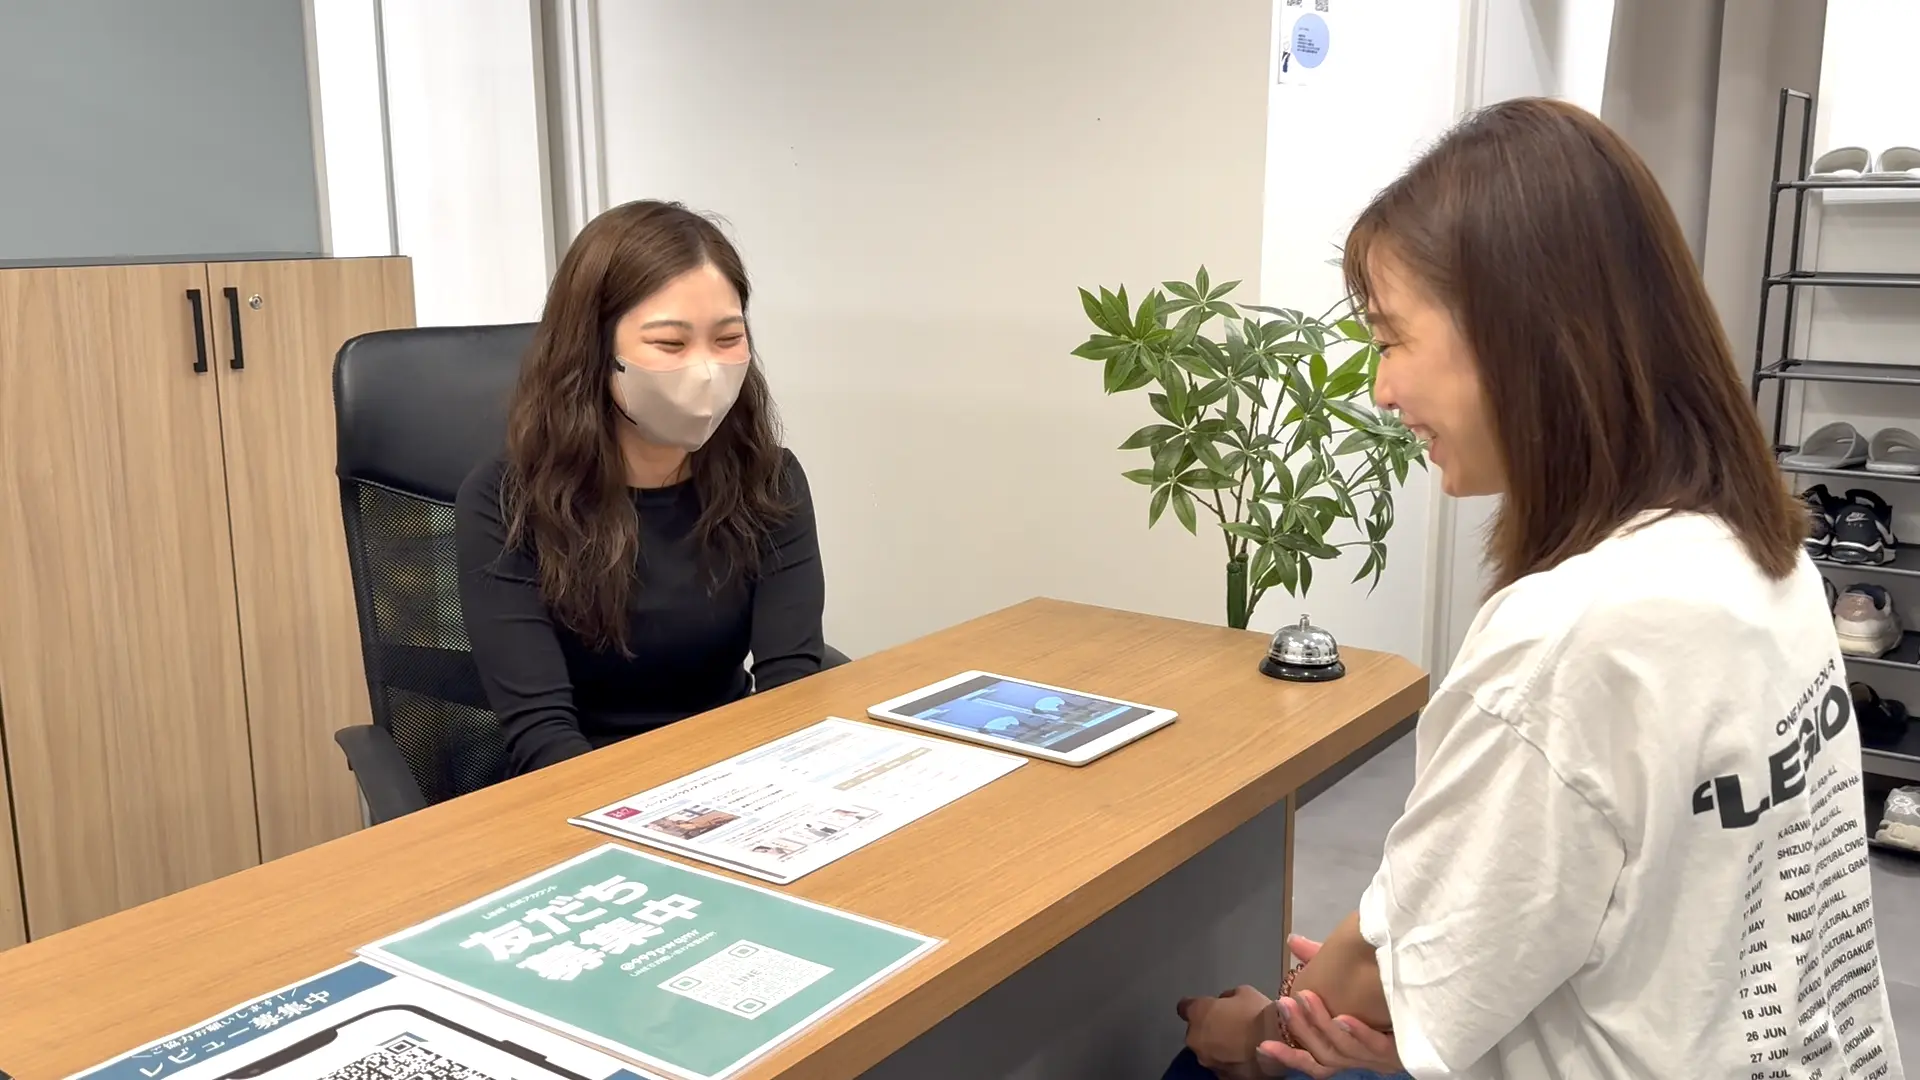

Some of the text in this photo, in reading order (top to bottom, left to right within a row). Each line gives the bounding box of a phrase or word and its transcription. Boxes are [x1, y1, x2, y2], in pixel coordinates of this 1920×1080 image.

[1844, 836, 1865, 853] CIVIC
[1847, 856, 1868, 874] GRAN
[1749, 898, 1763, 916] MAY
[1852, 898, 1871, 915] ARTS
[459, 874, 649, 962] 友だち
[1856, 917, 1874, 936] ARTS
[1748, 919, 1765, 935] MAY
[516, 893, 703, 981] 募集中
[1748, 940, 1768, 954] JUN
[1740, 961, 1772, 979] 11 JUN
[1739, 983, 1777, 999] 17 JUN
[1742, 1005, 1782, 1020] 18 JUN
[139, 990, 330, 1078] レビュー募集中
[1746, 1027, 1787, 1042] 26 JUN
[1750, 1048, 1789, 1063] 27 JUN
[1801, 1041, 1832, 1065] OKINAWA
[1751, 1069, 1791, 1080] 06 JUL
